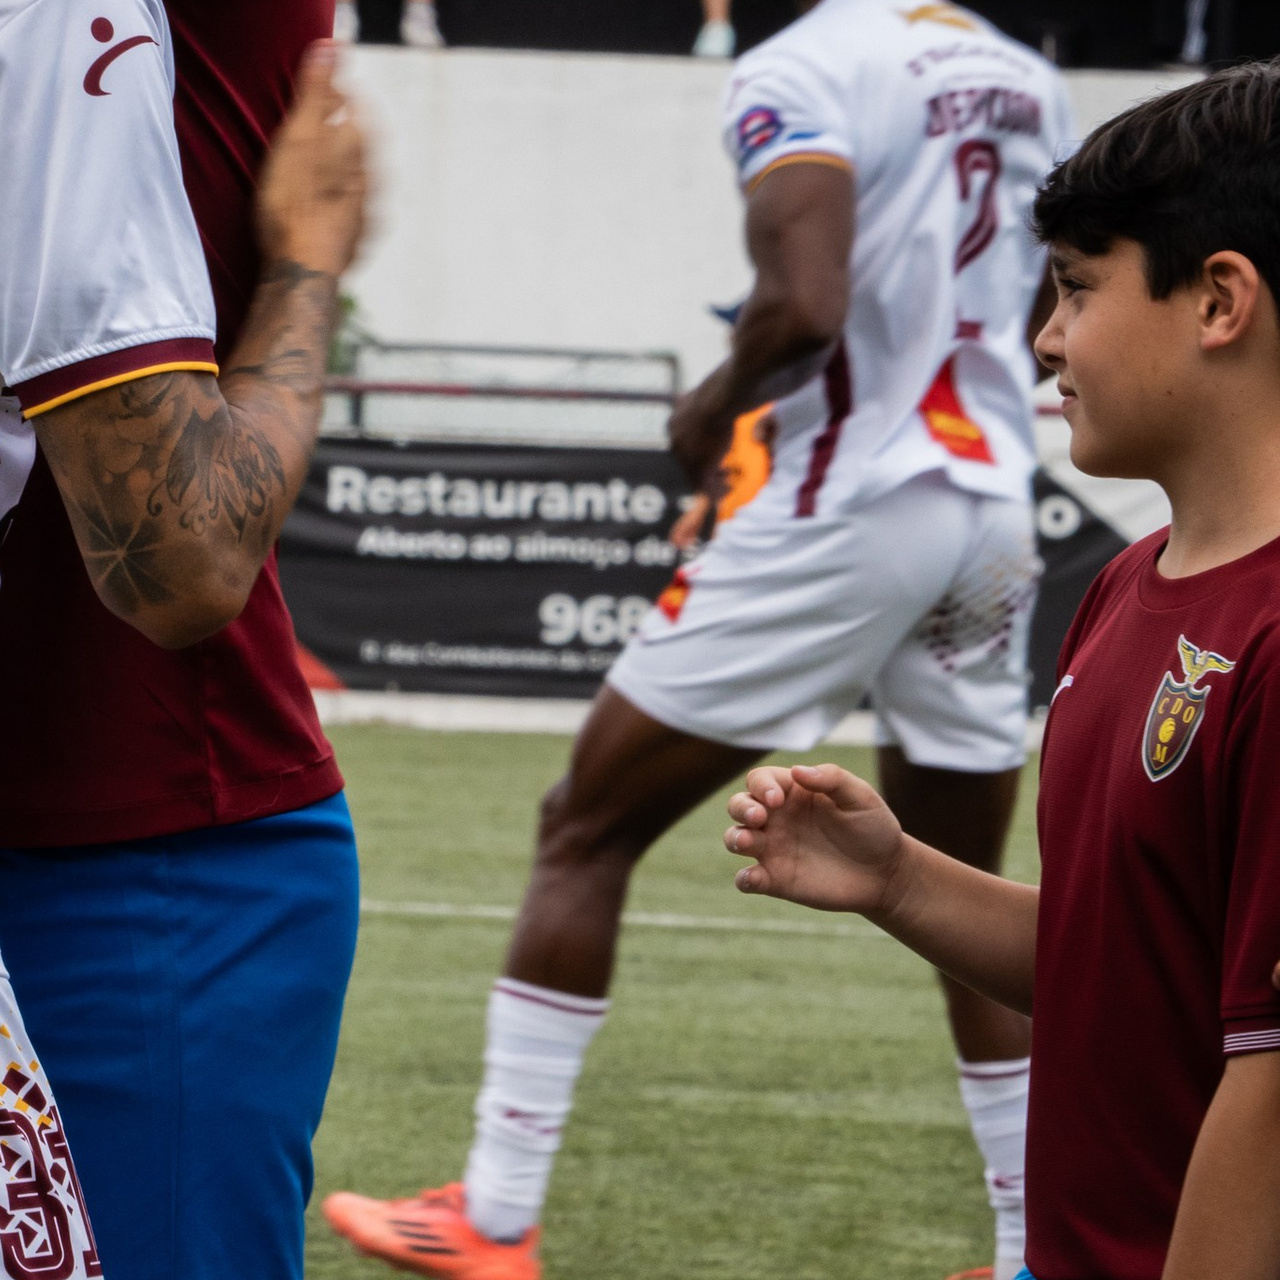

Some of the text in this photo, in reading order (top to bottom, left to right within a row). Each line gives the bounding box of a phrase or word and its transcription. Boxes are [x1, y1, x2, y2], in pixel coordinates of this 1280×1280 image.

[326, 465, 667, 523] Restaurante
[357, 527, 467, 561] Aberto
[470, 535, 511, 562] ao
